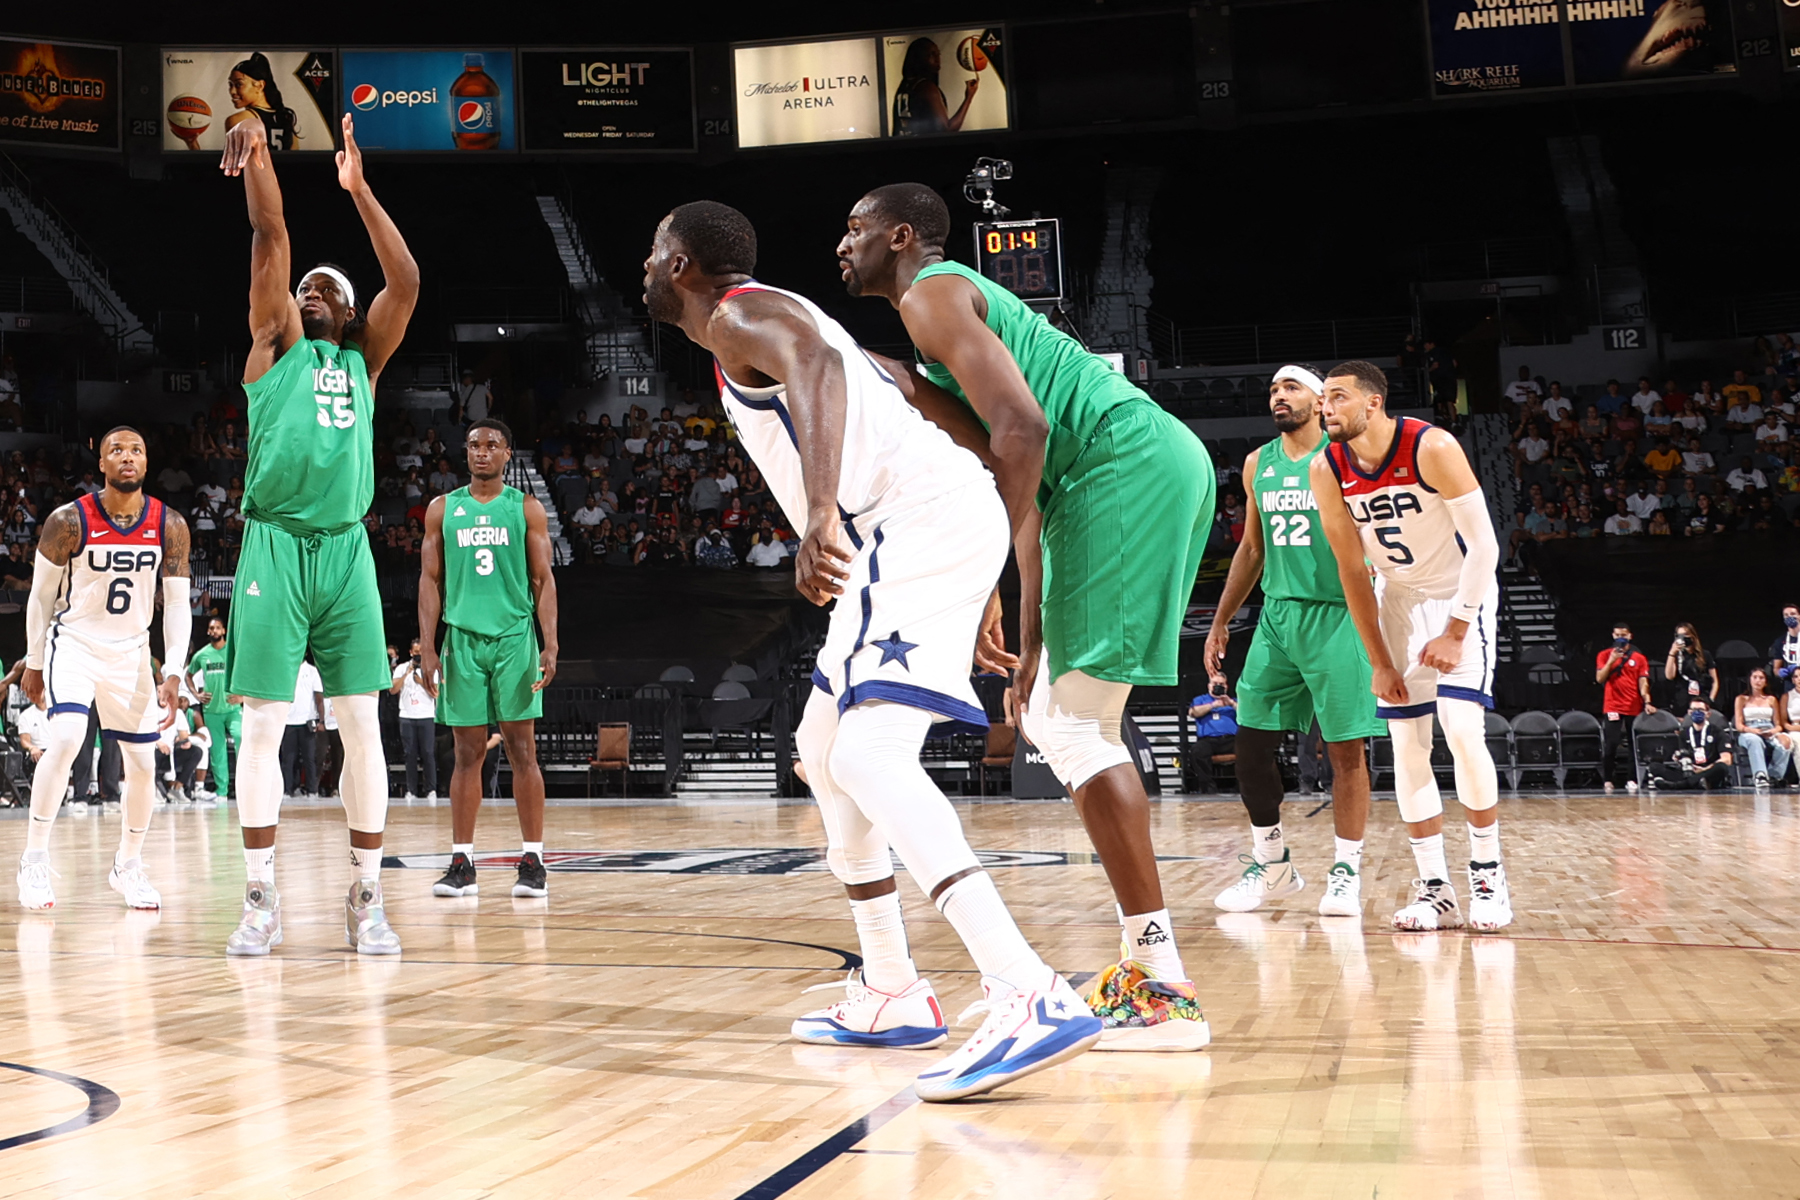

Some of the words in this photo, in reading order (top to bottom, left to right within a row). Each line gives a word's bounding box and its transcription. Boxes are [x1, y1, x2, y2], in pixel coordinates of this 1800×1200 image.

[1454, 4, 1559, 31] AHHHHH
[1741, 40, 1770, 57] 212
[562, 62, 650, 86] LIGHT
[1435, 67, 1484, 82] SHARK
[1486, 65, 1519, 78] REEF
[1468, 76, 1520, 89] AQUARIUM
[48, 75, 102, 97] BLUES
[744, 81, 799, 97] Michelob
[814, 75, 870, 90] ULTRA
[1202, 82, 1229, 99] 213
[382, 87, 437, 108] pepsi
[783, 97, 834, 110] ARENA
[11, 116, 29, 128] of
[31, 116, 60, 129] Live
[61, 119, 99, 133] Music
[485, 102, 493, 128] pepsi
[132, 120, 157, 135] 215
[704, 120, 730, 135] 214
[271, 128, 284, 150] 5
[986, 230, 1037, 254] 01.4
[1611, 329, 1638, 348] 112
[170, 374, 192, 391] 115
[625, 376, 650, 395] 114
[1262, 489, 1319, 512] NIGERIA
[1346, 492, 1422, 523] USA
[457, 526, 509, 548] NIGERIA
[1269, 514, 1311, 546] 22
[1374, 526, 1415, 565] 5
[88, 550, 157, 572] USA
[475, 548, 495, 576] 3
[106, 577, 134, 614] 6
[1137, 933, 1170, 947] PEAK
